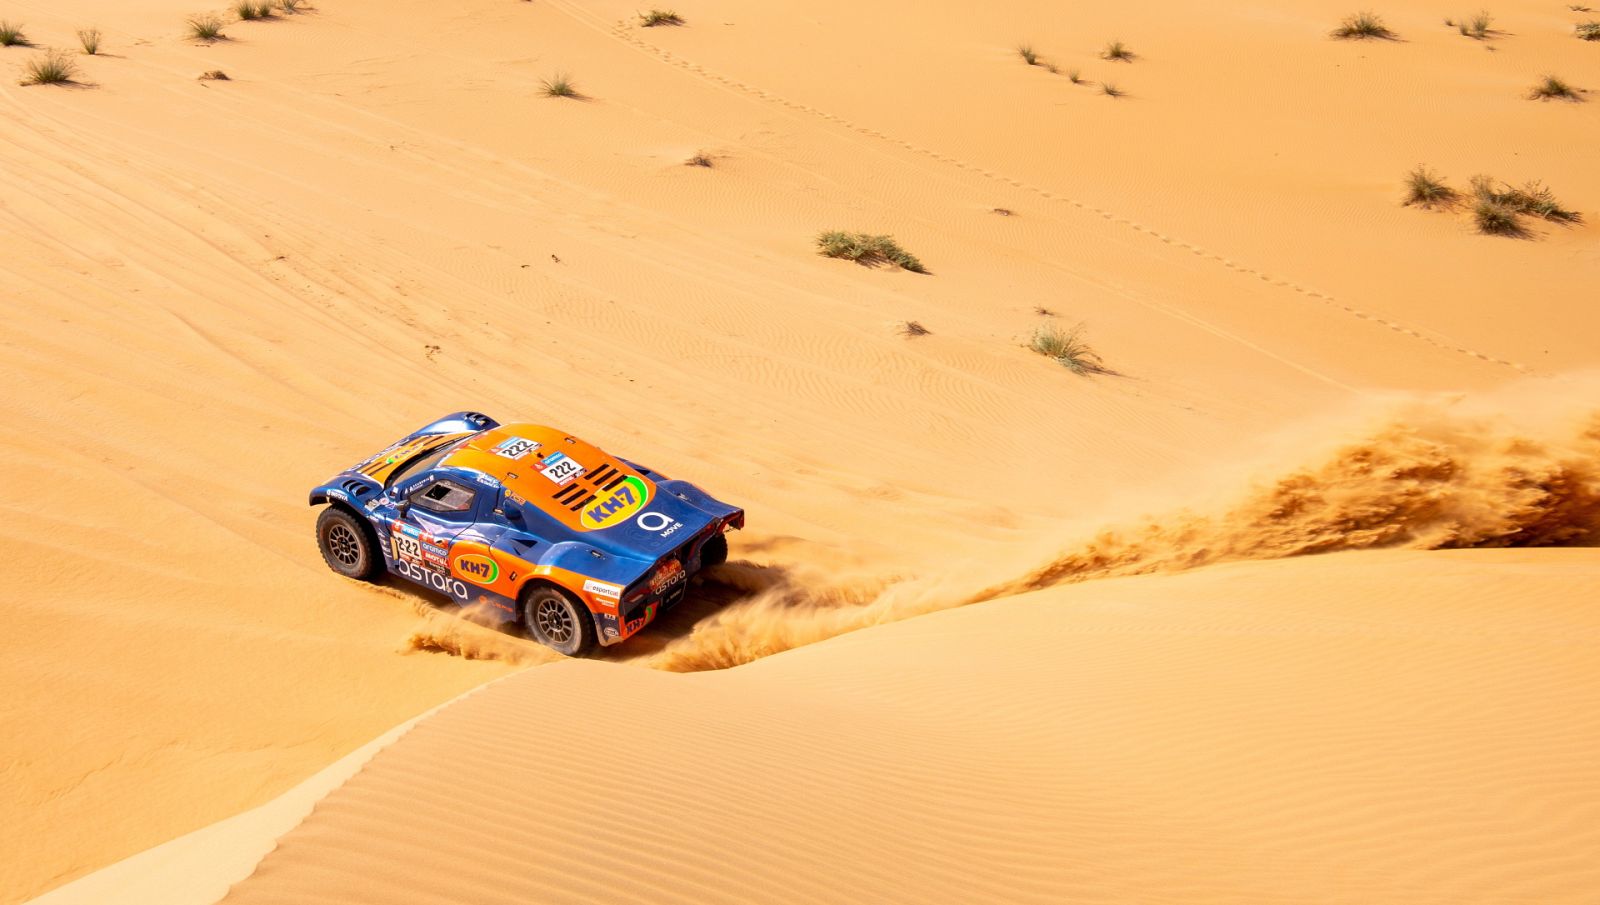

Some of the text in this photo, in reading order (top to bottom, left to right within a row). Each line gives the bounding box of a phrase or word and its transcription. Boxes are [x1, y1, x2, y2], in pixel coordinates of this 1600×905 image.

[502, 440, 535, 457] 222
[549, 461, 577, 479] 222
[637, 511, 675, 531] a
[660, 522, 684, 538] MOVE
[397, 537, 420, 557] 222
[422, 543, 447, 556] aramco
[425, 552, 448, 566] MOTUL
[399, 558, 469, 600] astara
[655, 569, 686, 595] astara
